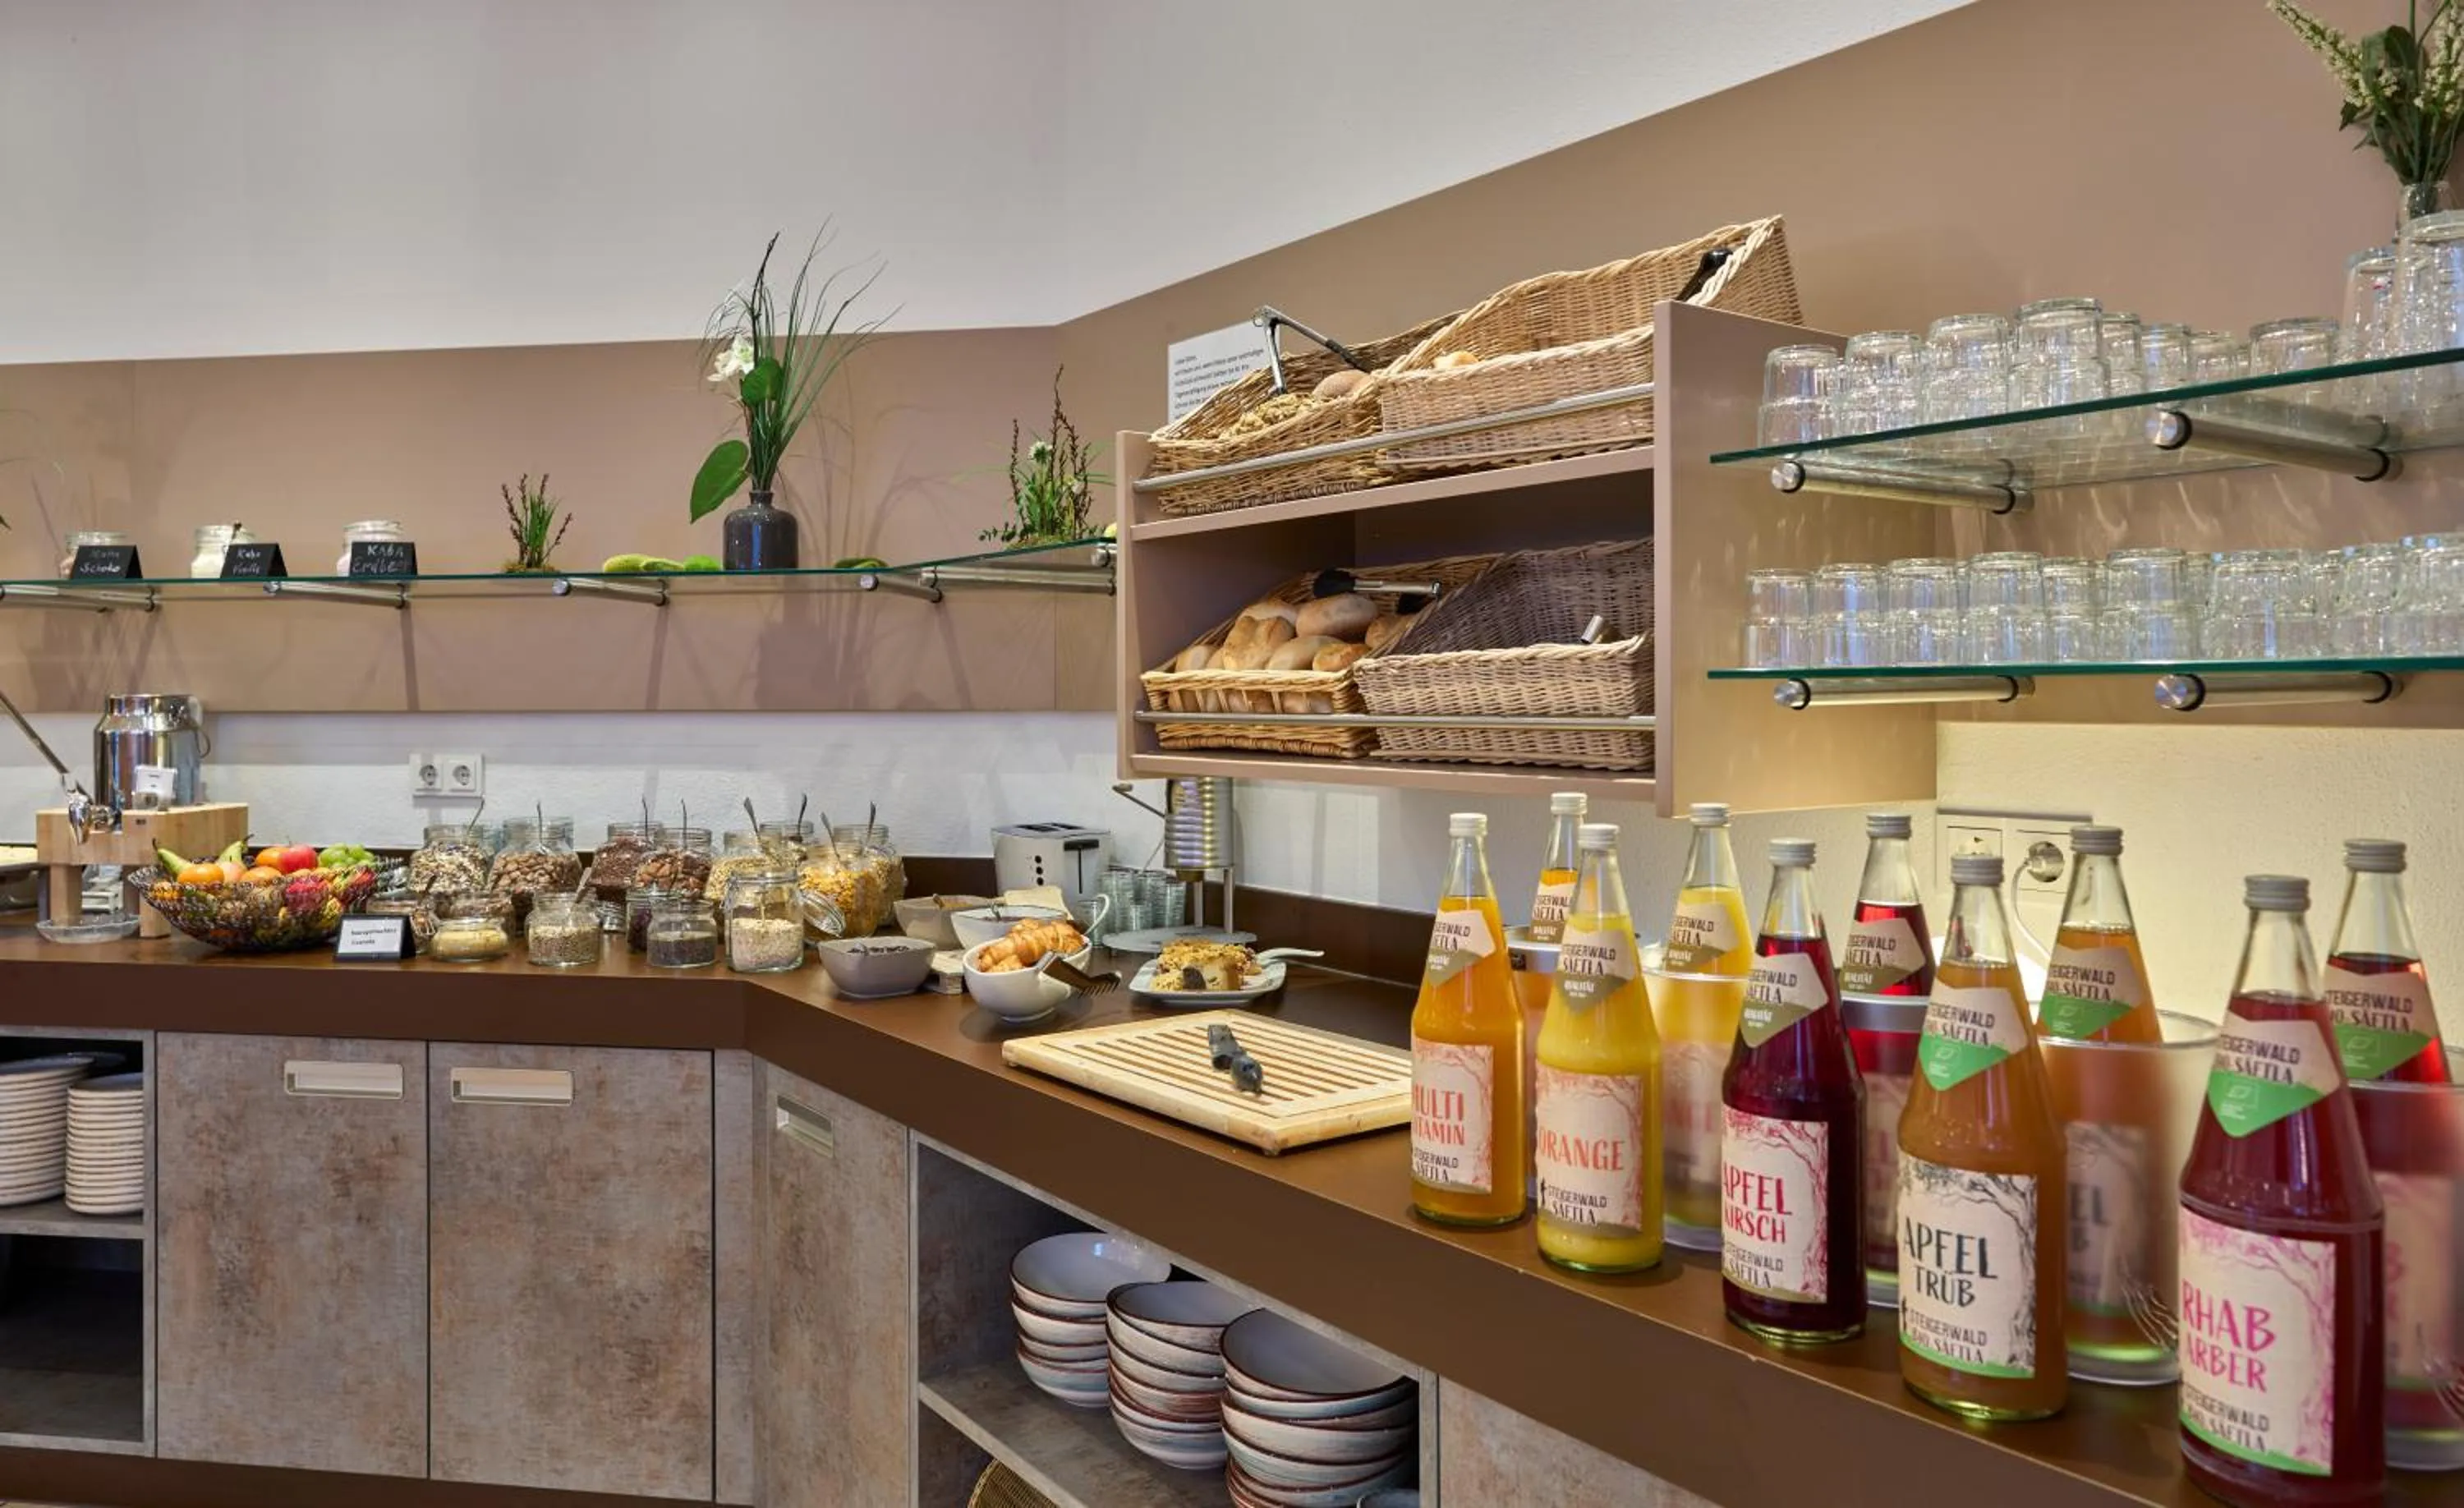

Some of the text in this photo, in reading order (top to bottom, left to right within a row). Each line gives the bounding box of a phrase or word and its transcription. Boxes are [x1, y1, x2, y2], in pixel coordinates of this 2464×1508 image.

[1538, 1126, 1625, 1171] ORANGE
[1722, 1161, 1793, 1216] APFEL
[1903, 1216, 1999, 1280] APFEL
[1915, 1265, 1976, 1308] TRÜB
[2182, 1277, 2277, 1354] RHAB
[2186, 1333, 2268, 1394] ARBER
